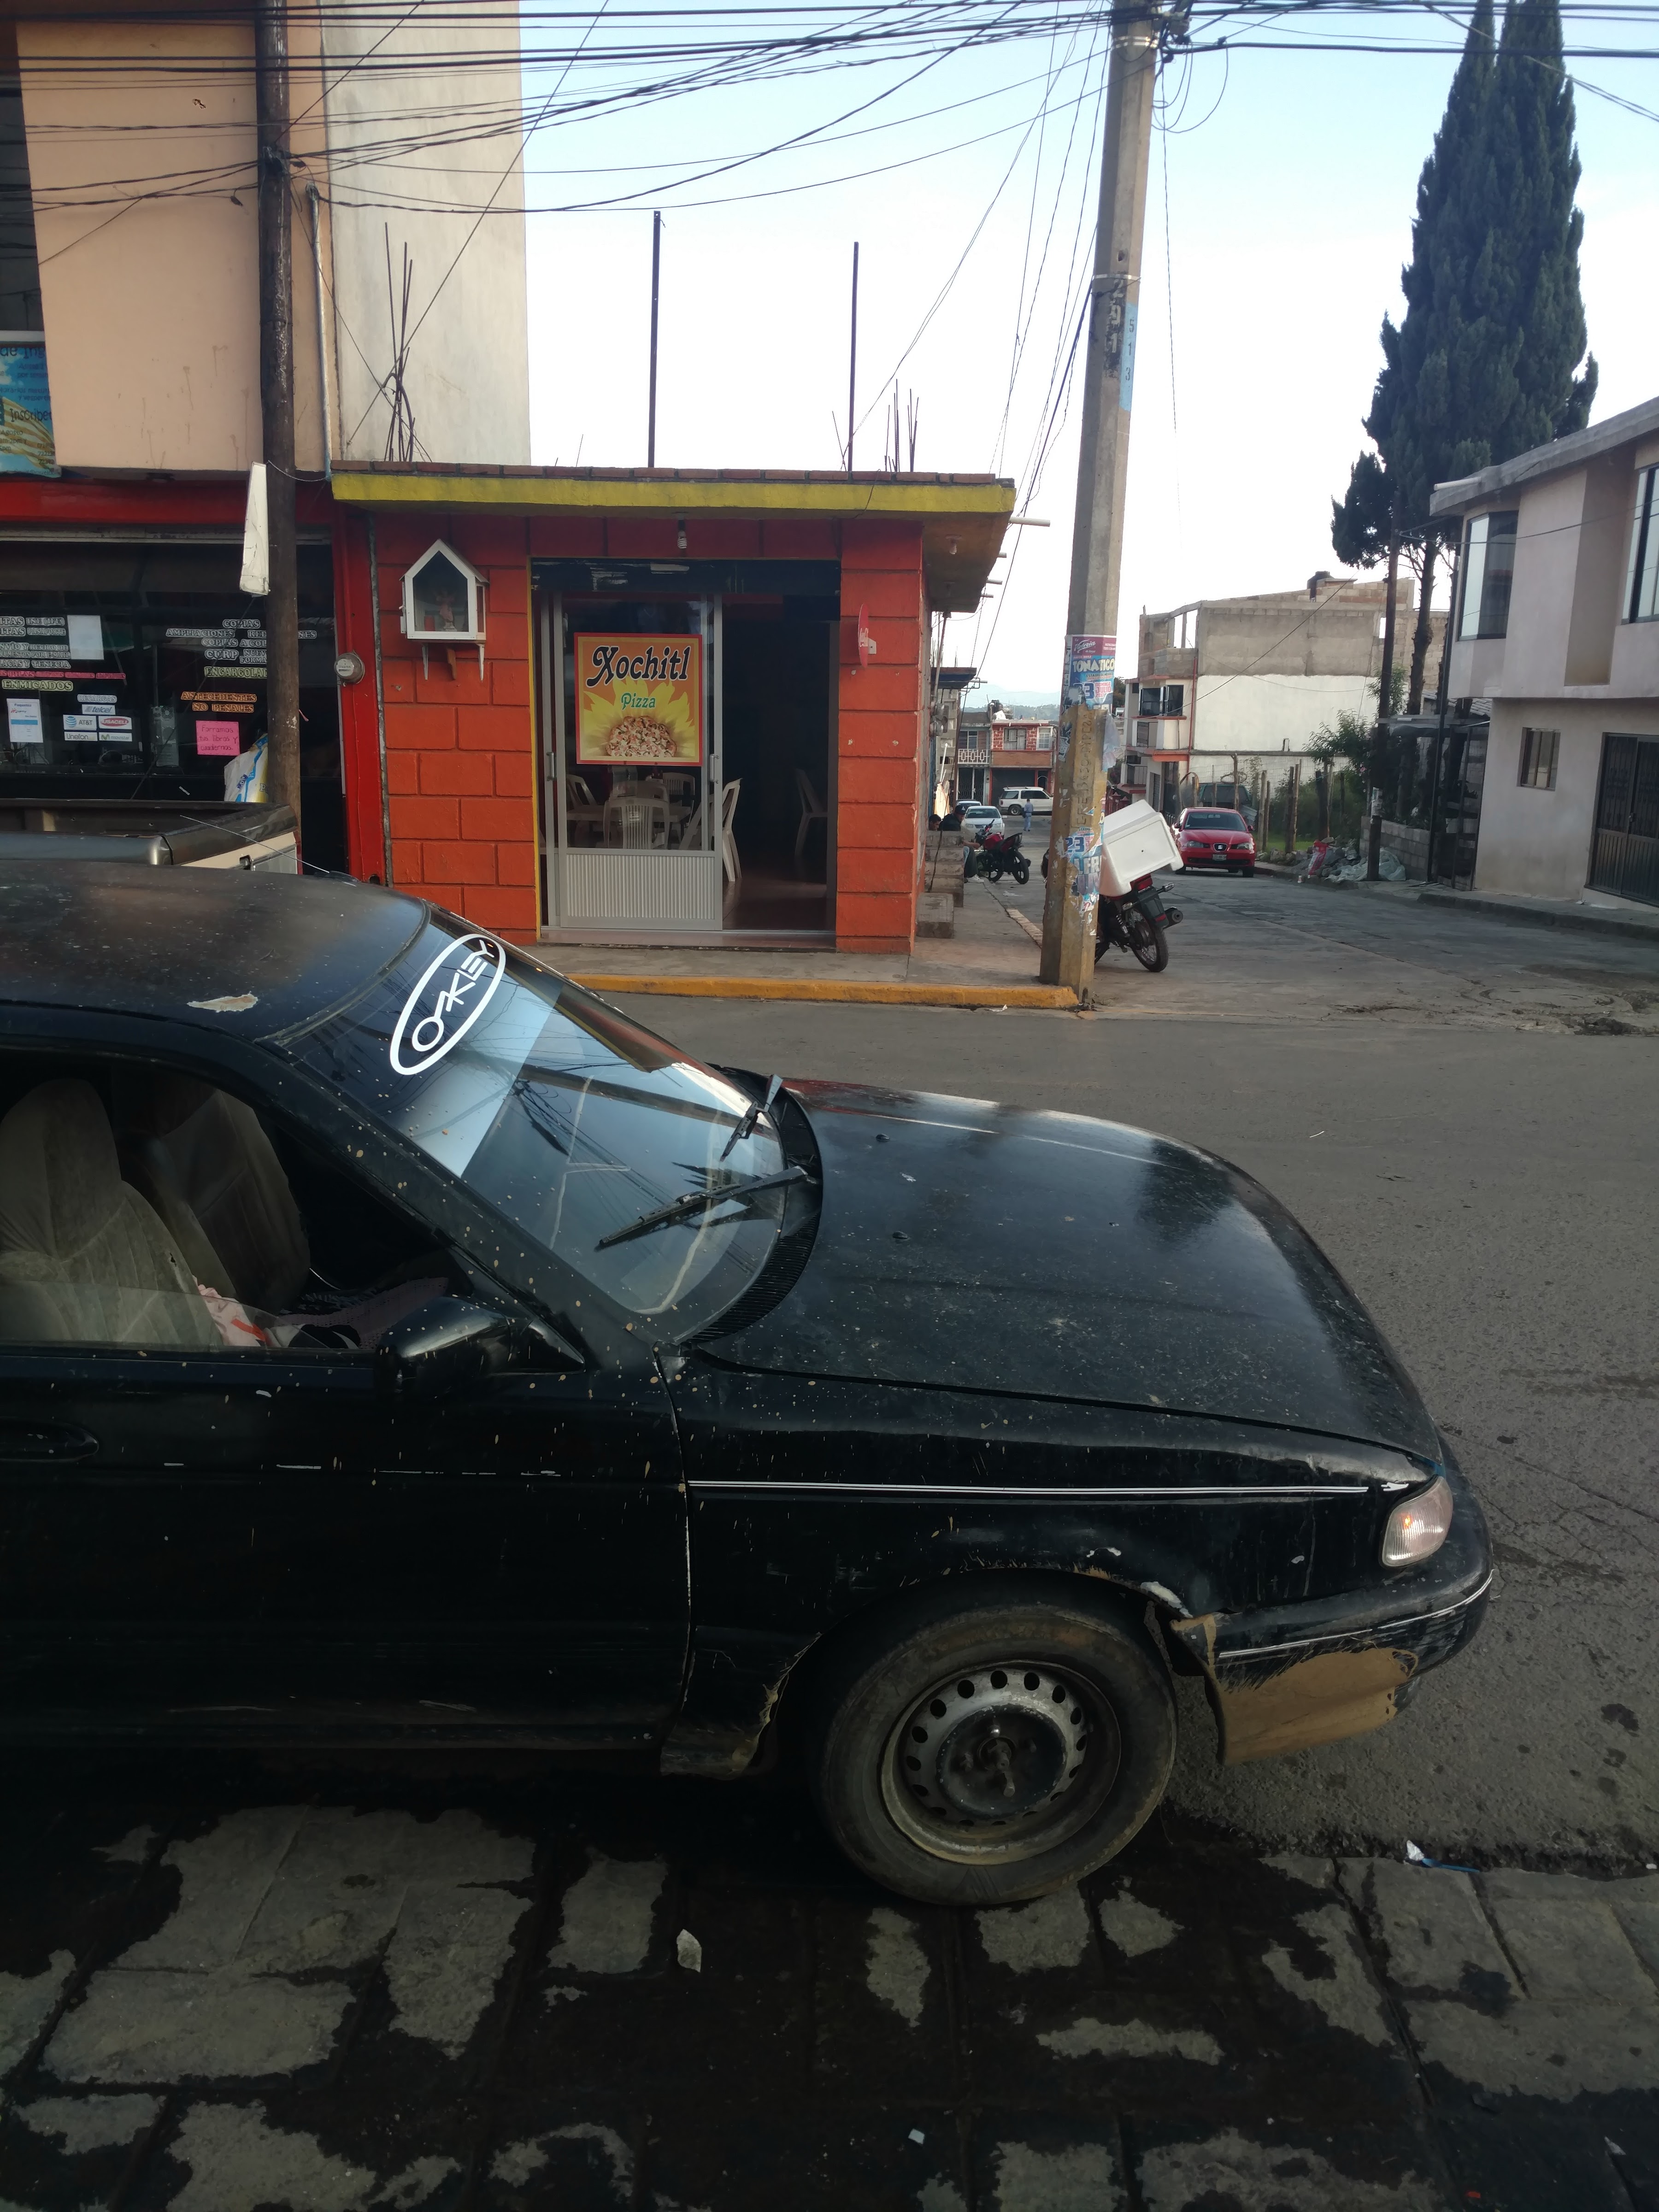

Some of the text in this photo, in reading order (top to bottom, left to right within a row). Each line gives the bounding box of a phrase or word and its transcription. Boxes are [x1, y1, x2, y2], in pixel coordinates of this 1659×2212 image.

[166, 629, 235, 637] AMPLIACIONES
[202, 638, 238, 647] COPIAS
[205, 649, 239, 659] CURP
[586, 646, 691, 688] Xochitl
[1072, 659, 1115, 672] TONATICO
[3, 680, 73, 691] ENMICADOS
[181, 692, 257, 702] ANTECEDENTES
[620, 692, 656, 710] Pizza
[212, 704, 254, 712] PENALES
[201, 724, 233, 733] Forramos
[412, 940, 494, 1052] OAKLEY
